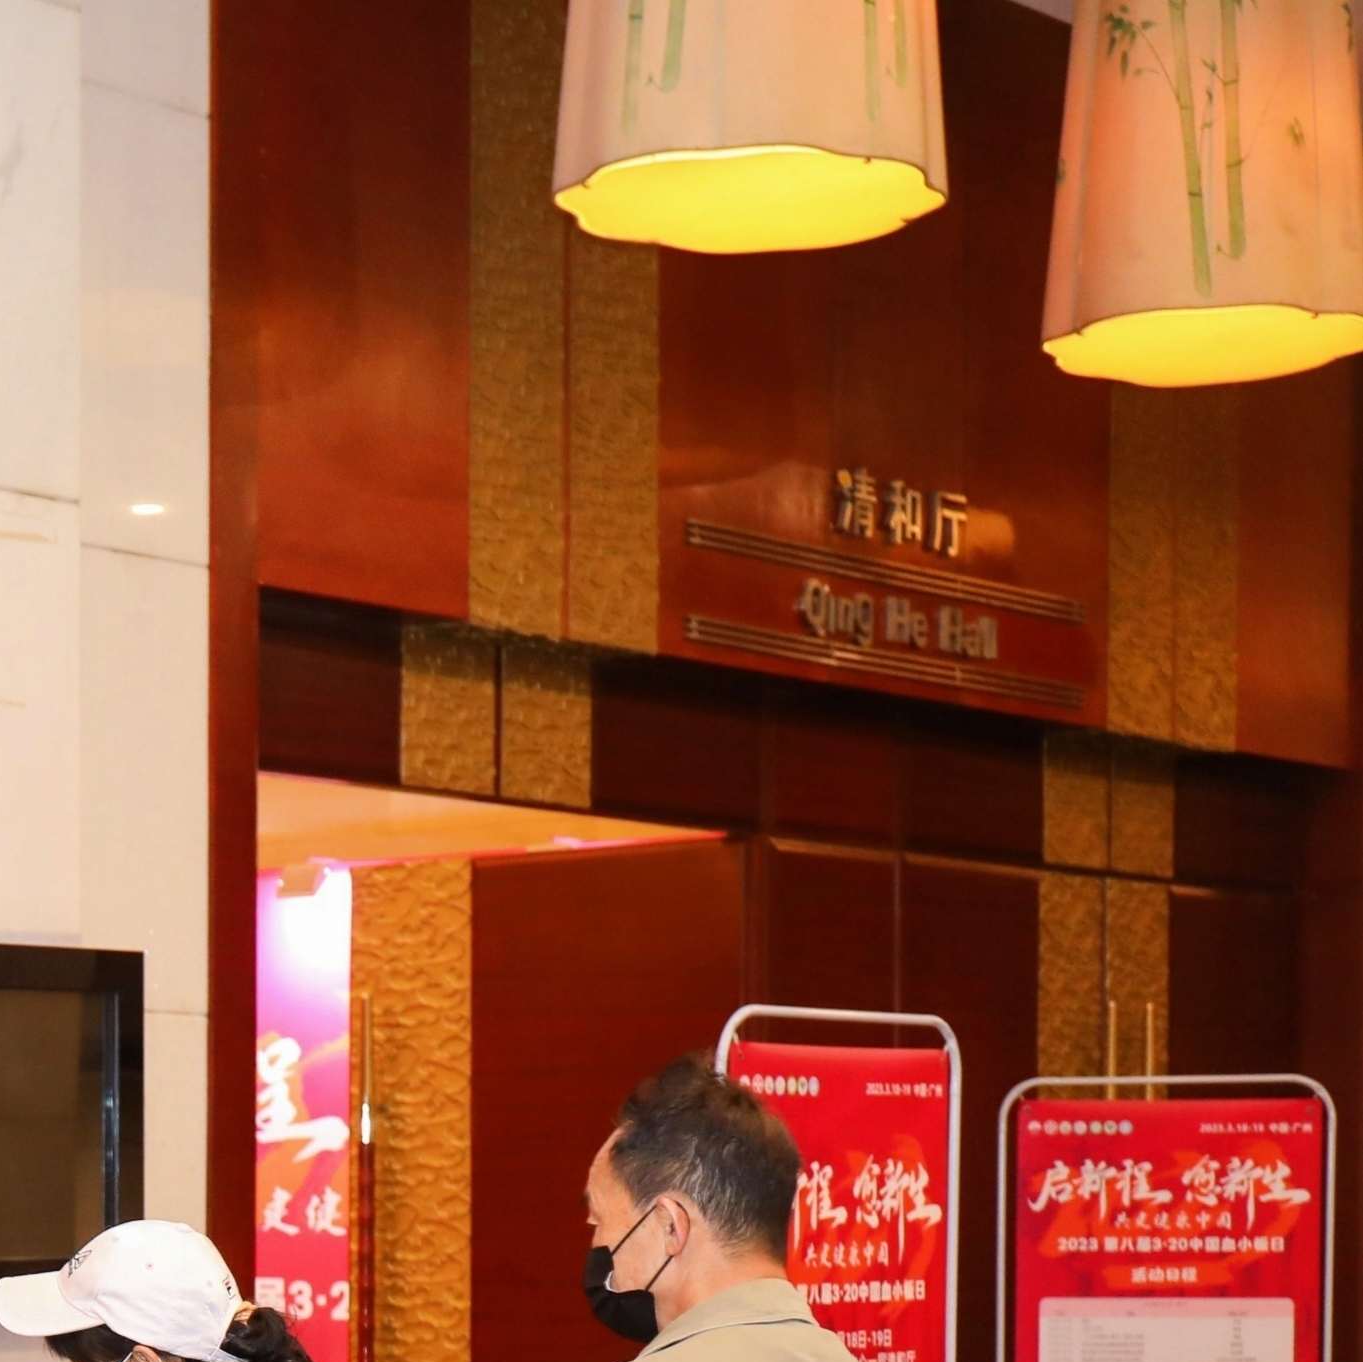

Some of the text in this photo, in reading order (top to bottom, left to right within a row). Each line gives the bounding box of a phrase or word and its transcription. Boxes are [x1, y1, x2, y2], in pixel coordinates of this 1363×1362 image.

[834, 467, 968, 557] 清和厅
[799, 577, 998, 660] Qing He Hall
[1057, 1235, 1099, 1253] 2023
